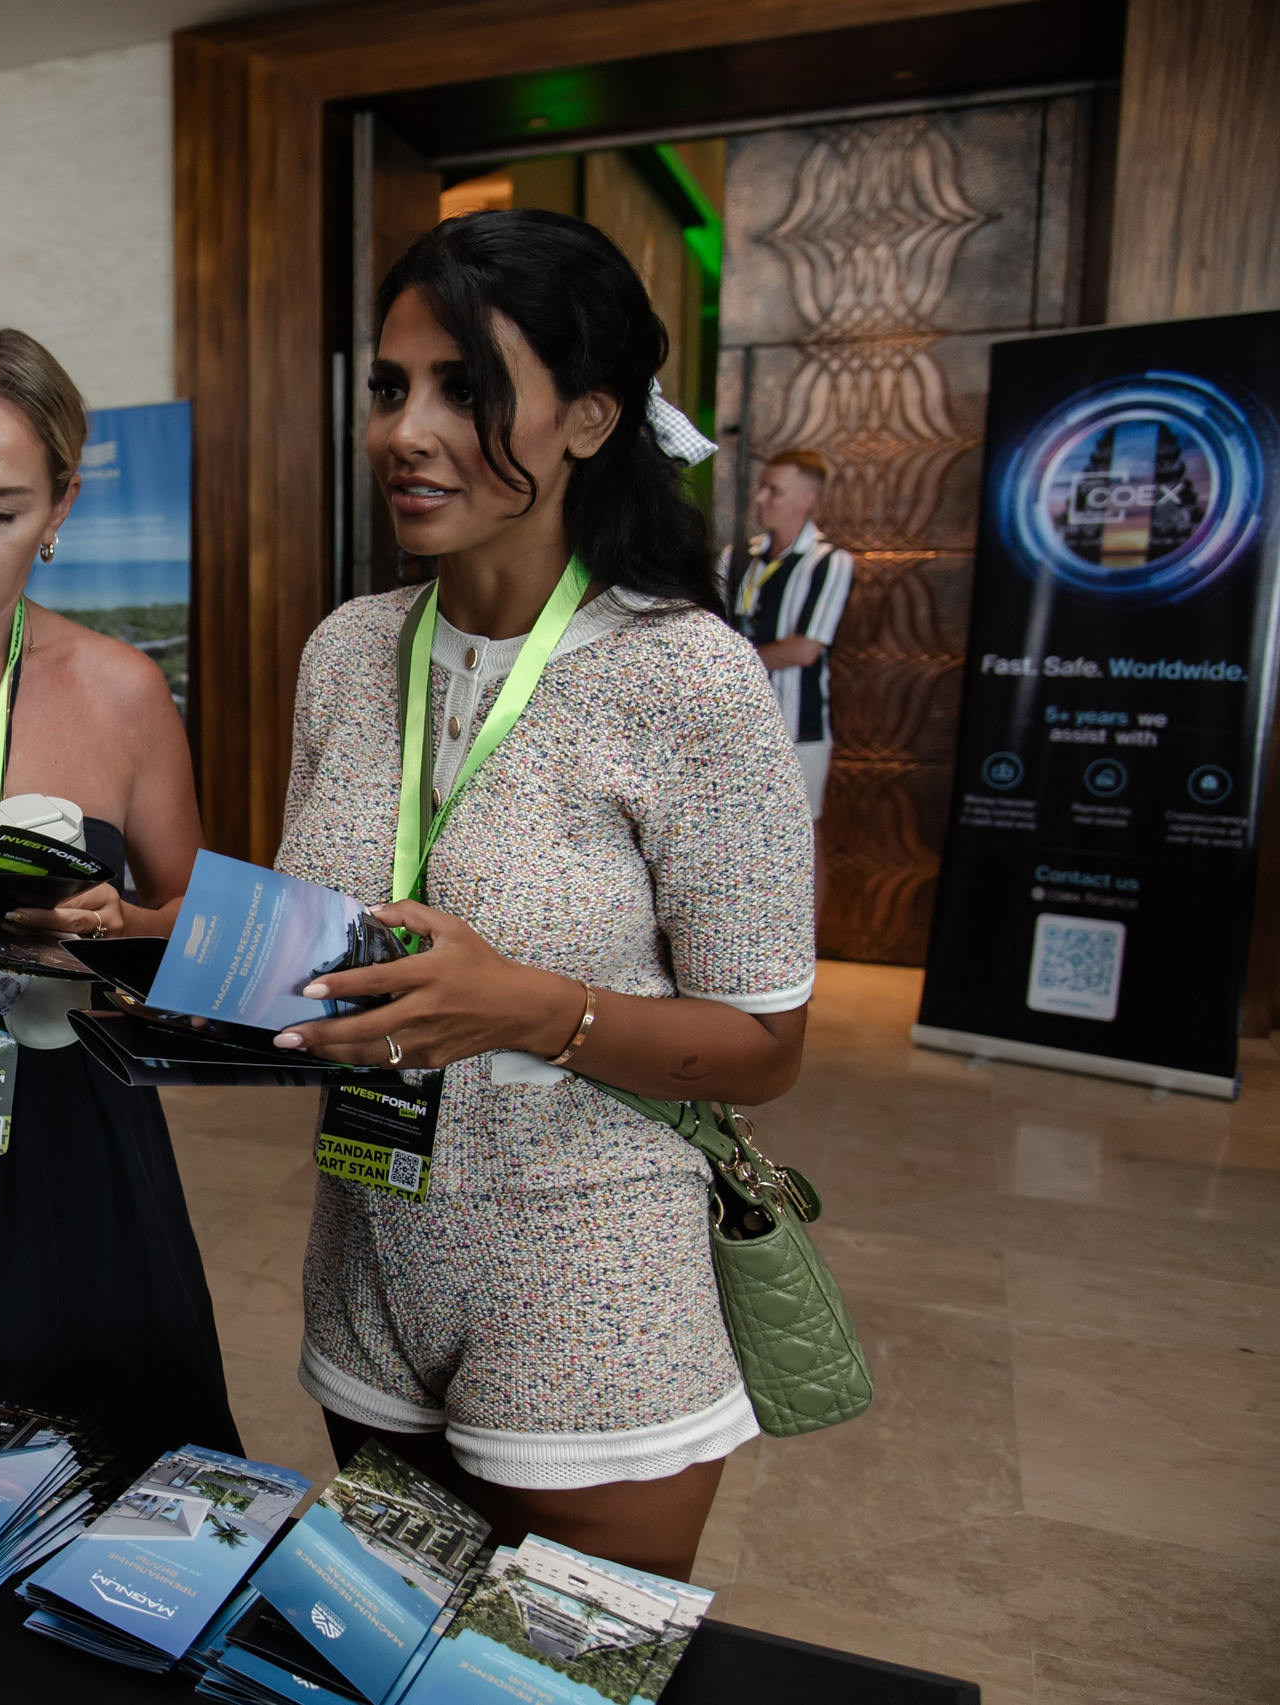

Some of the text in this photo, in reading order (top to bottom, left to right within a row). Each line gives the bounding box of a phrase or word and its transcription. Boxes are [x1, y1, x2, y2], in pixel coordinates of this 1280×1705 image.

[1086, 483, 1184, 508] COEX
[982, 654, 1249, 681] Fast. Safe. Worldwide.
[1049, 728, 1158, 747] assist with
[1075, 709, 1129, 726] years
[1137, 712, 1167, 728] we
[1035, 865, 1111, 889] Contact
[212, 954, 241, 1011] MAGNUM
[236, 881, 263, 953] RESIDENCE
[240, 921, 264, 976] BERAWA
[318, 1139, 392, 1164] STANDART
[107, 1551, 197, 1597] ПРЕМИАЛЬНЫЕ
[136, 1554, 178, 1577] ВИЛЛЫ
[294, 1547, 352, 1601] RESIDENCE
[91, 1572, 175, 1617] MAGNUM
[325, 1564, 379, 1613] SEMINYAK
[353, 1600, 404, 1648] MAGNUM
[460, 1660, 533, 1703] RESIDENCE
